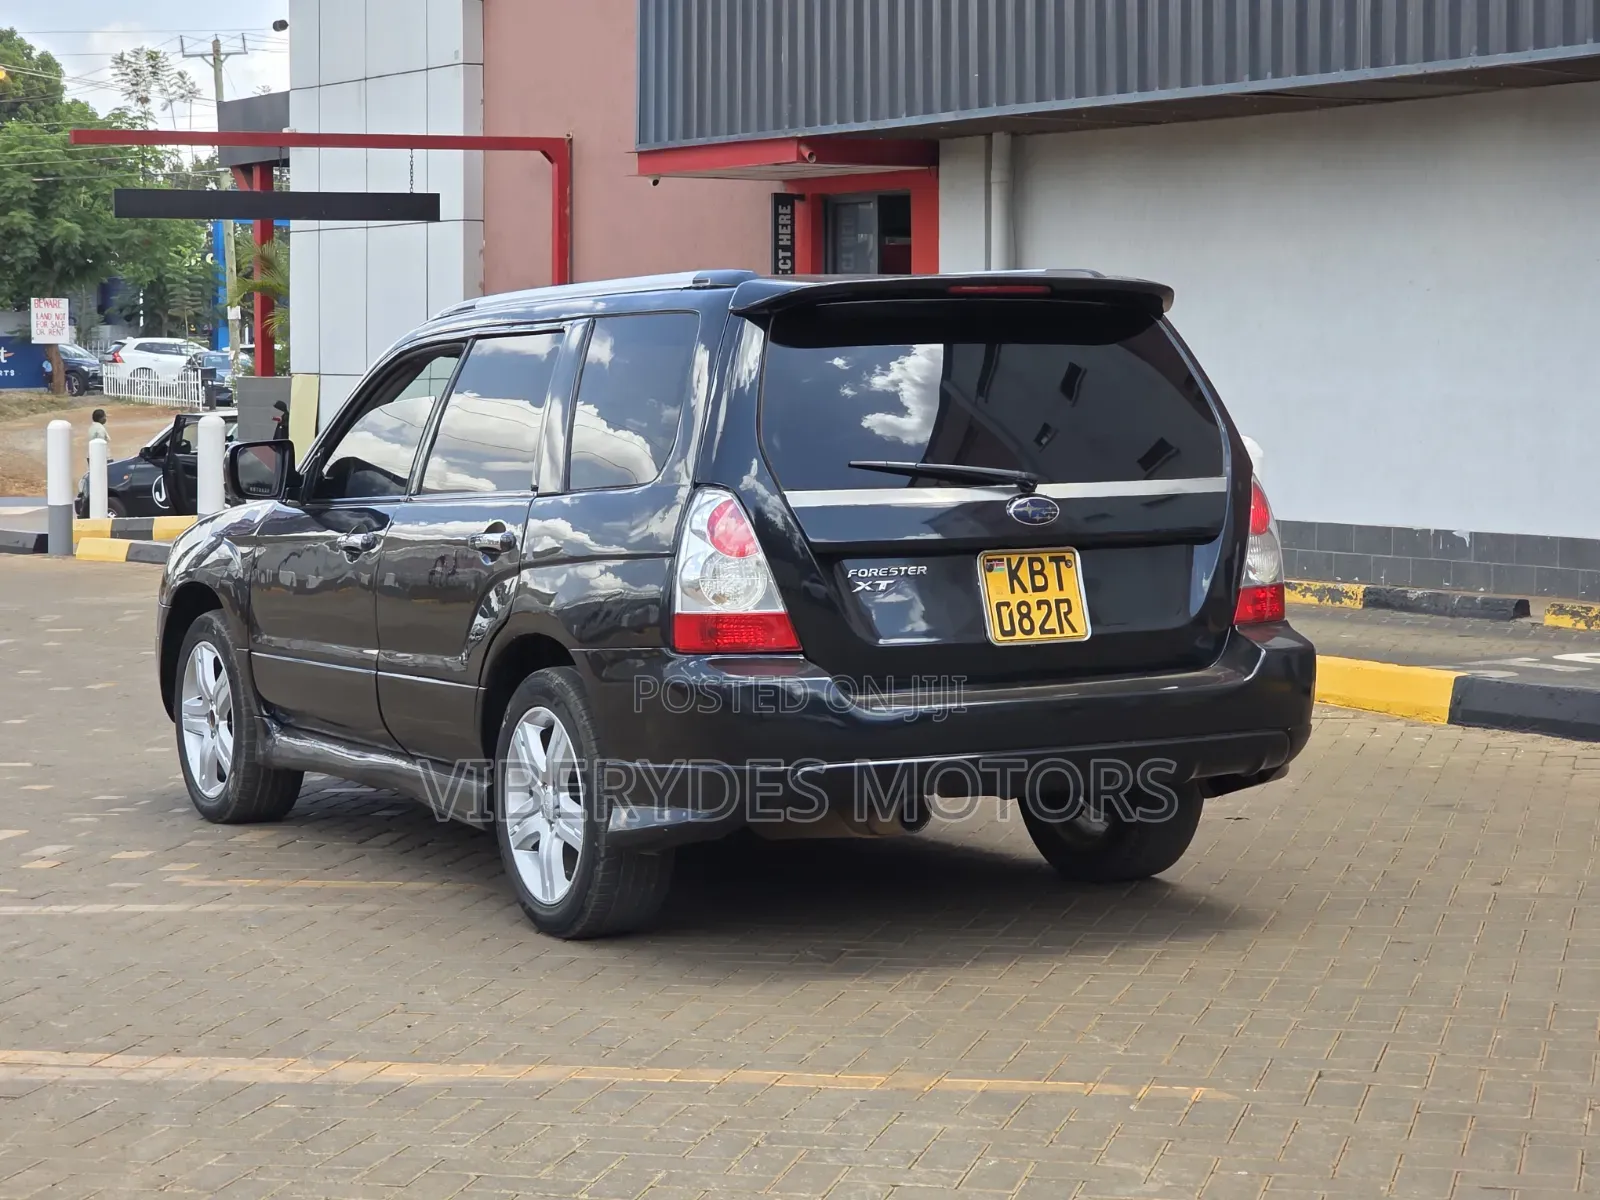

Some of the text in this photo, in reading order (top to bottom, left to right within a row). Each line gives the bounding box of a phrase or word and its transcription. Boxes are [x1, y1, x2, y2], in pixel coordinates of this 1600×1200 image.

[778, 205, 792, 274] CT HERE
[34, 299, 62, 309] BEWARE
[36, 313, 66, 321] LAND NOT
[36, 320, 66, 329] FOR SALE
[847, 565, 928, 579] FORESTER
[1006, 555, 1067, 595] KBT
[852, 580, 896, 593] XT
[995, 598, 1078, 638] 082R
